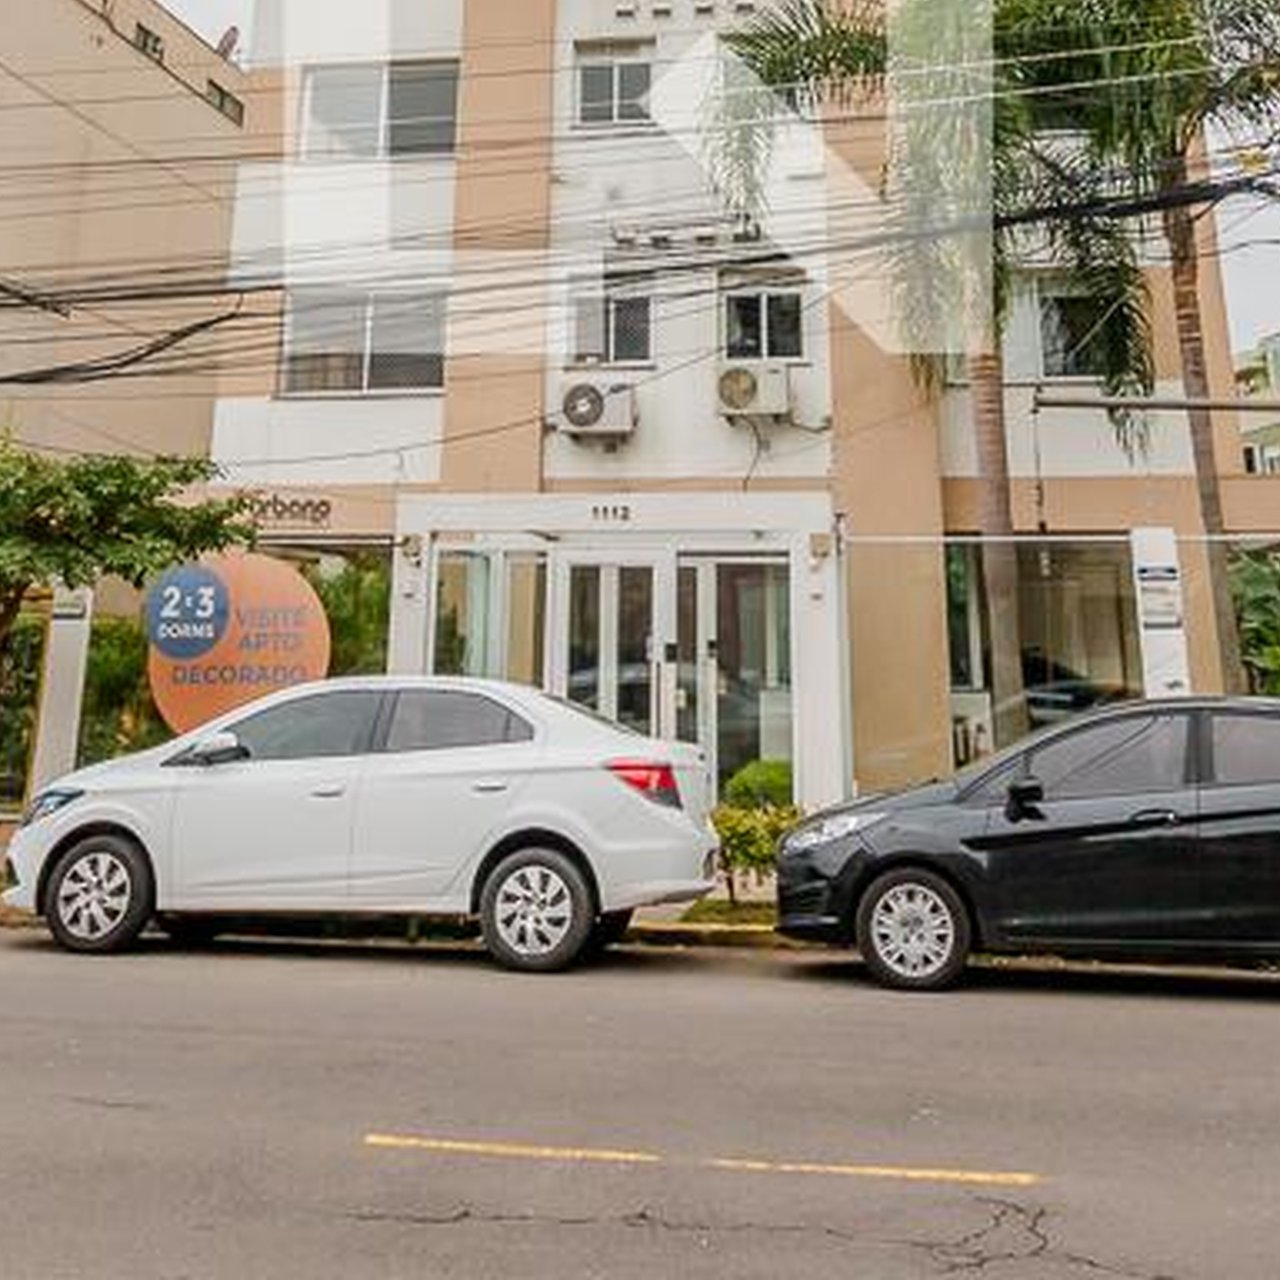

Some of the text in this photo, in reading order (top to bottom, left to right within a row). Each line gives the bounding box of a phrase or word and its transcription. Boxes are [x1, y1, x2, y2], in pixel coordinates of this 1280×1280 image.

[591, 505, 630, 521] 1112
[157, 621, 215, 639] DORMS
[172, 665, 307, 685] DECORADO
